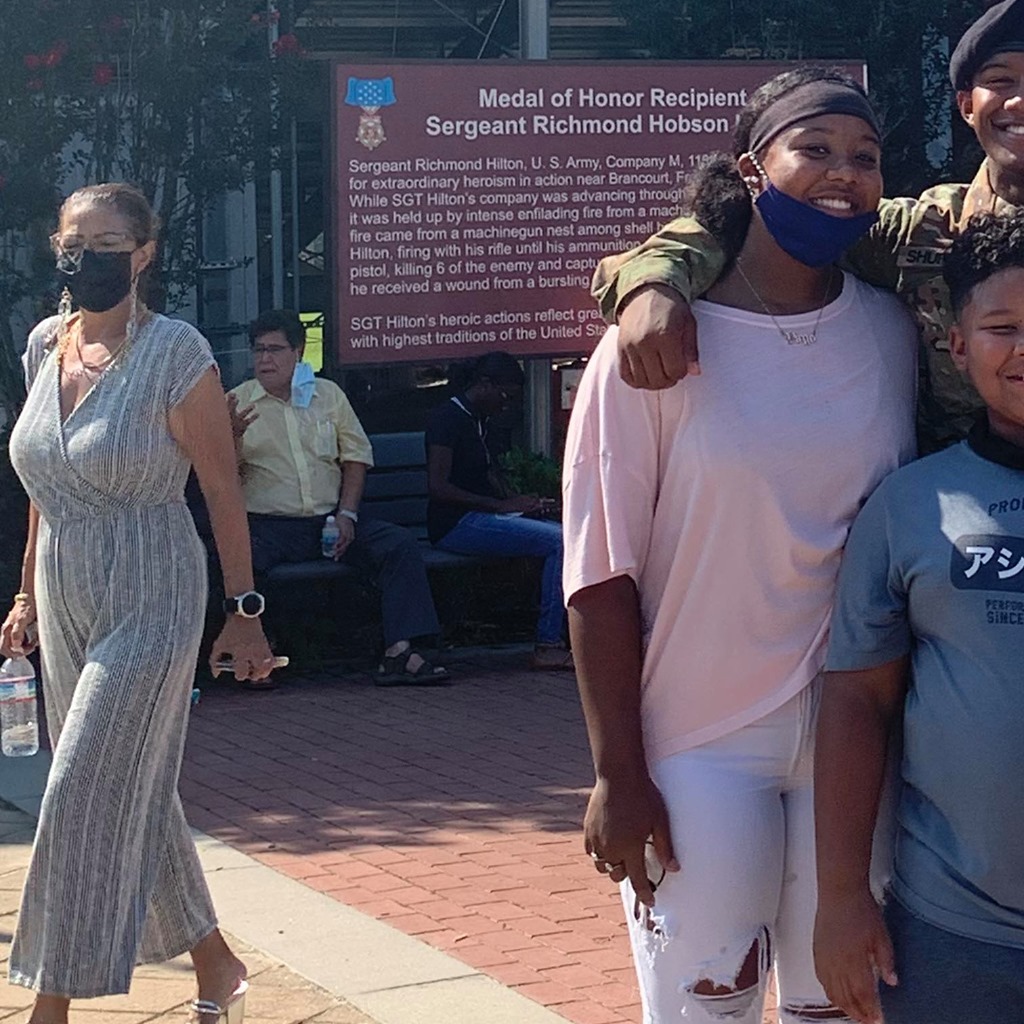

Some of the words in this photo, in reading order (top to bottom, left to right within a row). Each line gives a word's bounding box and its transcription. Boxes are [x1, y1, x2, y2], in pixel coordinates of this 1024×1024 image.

[479, 88, 544, 108] Medal
[551, 88, 573, 108] of
[579, 88, 644, 108] Honor
[650, 88, 747, 110] Recipient
[426, 115, 526, 140] Sergeant
[533, 115, 642, 134] Richmond
[650, 115, 728, 133] Hobson
[349, 159, 411, 175] Sergeant
[416, 157, 482, 171] Richmond
[486, 157, 527, 171] Hilton,
[566, 156, 601, 171] Army,
[606, 156, 664, 171] Company
[349, 176, 367, 190] for
[372, 176, 460, 192] extraordinary
[464, 175, 516, 188] heroism
[520, 175, 531, 187] in
[535, 174, 573, 187] action
[577, 174, 606, 185] near
[349, 194, 388, 208] While
[392, 193, 423, 207] SGT
[427, 192, 476, 206] Hilton's
[480, 192, 538, 207] company
[543, 191, 568, 202] was
[572, 188, 635, 204] advancing
[640, 188, 685, 203] through
[350, 212, 358, 225] it
[362, 214, 389, 224] was
[393, 210, 422, 224] held
[426, 213, 442, 226] up
[447, 210, 463, 225] by
[466, 208, 514, 222] intense
[518, 207, 579, 223] enfilading
[583, 206, 603, 219] fire
[606, 205, 634, 218] from
[638, 207, 646, 217] a
[350, 229, 371, 242] fire
[376, 230, 412, 242] came
[417, 227, 447, 240] from
[451, 230, 459, 240] a
[464, 225, 543, 241] machinegun
[547, 224, 574, 237] nest
[578, 225, 621, 238] among
[624, 221, 653, 234] shell
[350, 247, 393, 261] Hilton,
[397, 245, 430, 261] firing
[435, 244, 461, 257] with
[465, 243, 484, 256] his
[488, 242, 511, 255] rifle
[516, 241, 543, 254] until
[546, 241, 565, 253] his
[350, 264, 390, 279] pistol,
[394, 262, 432, 277] killing
[436, 262, 445, 275] 6
[449, 261, 462, 274] of
[466, 260, 486, 273] the
[490, 261, 534, 275] enemy
[537, 257, 562, 270] and
[350, 282, 367, 295] he
[372, 280, 429, 294] received
[434, 282, 442, 292] a
[446, 278, 490, 292] wound
[494, 277, 523, 290] from
[527, 280, 535, 290] a
[539, 274, 590, 290] bursting
[350, 316, 383, 331] SGT
[386, 314, 436, 329] Hilton's
[440, 312, 481, 327] heroic
[484, 311, 531, 325] actions
[535, 308, 574, 322] reflect
[350, 334, 378, 349] with
[382, 331, 432, 350] highest
[436, 328, 496, 344] traditions
[500, 327, 513, 341] of
[516, 327, 537, 340] the
[540, 324, 582, 339] United
